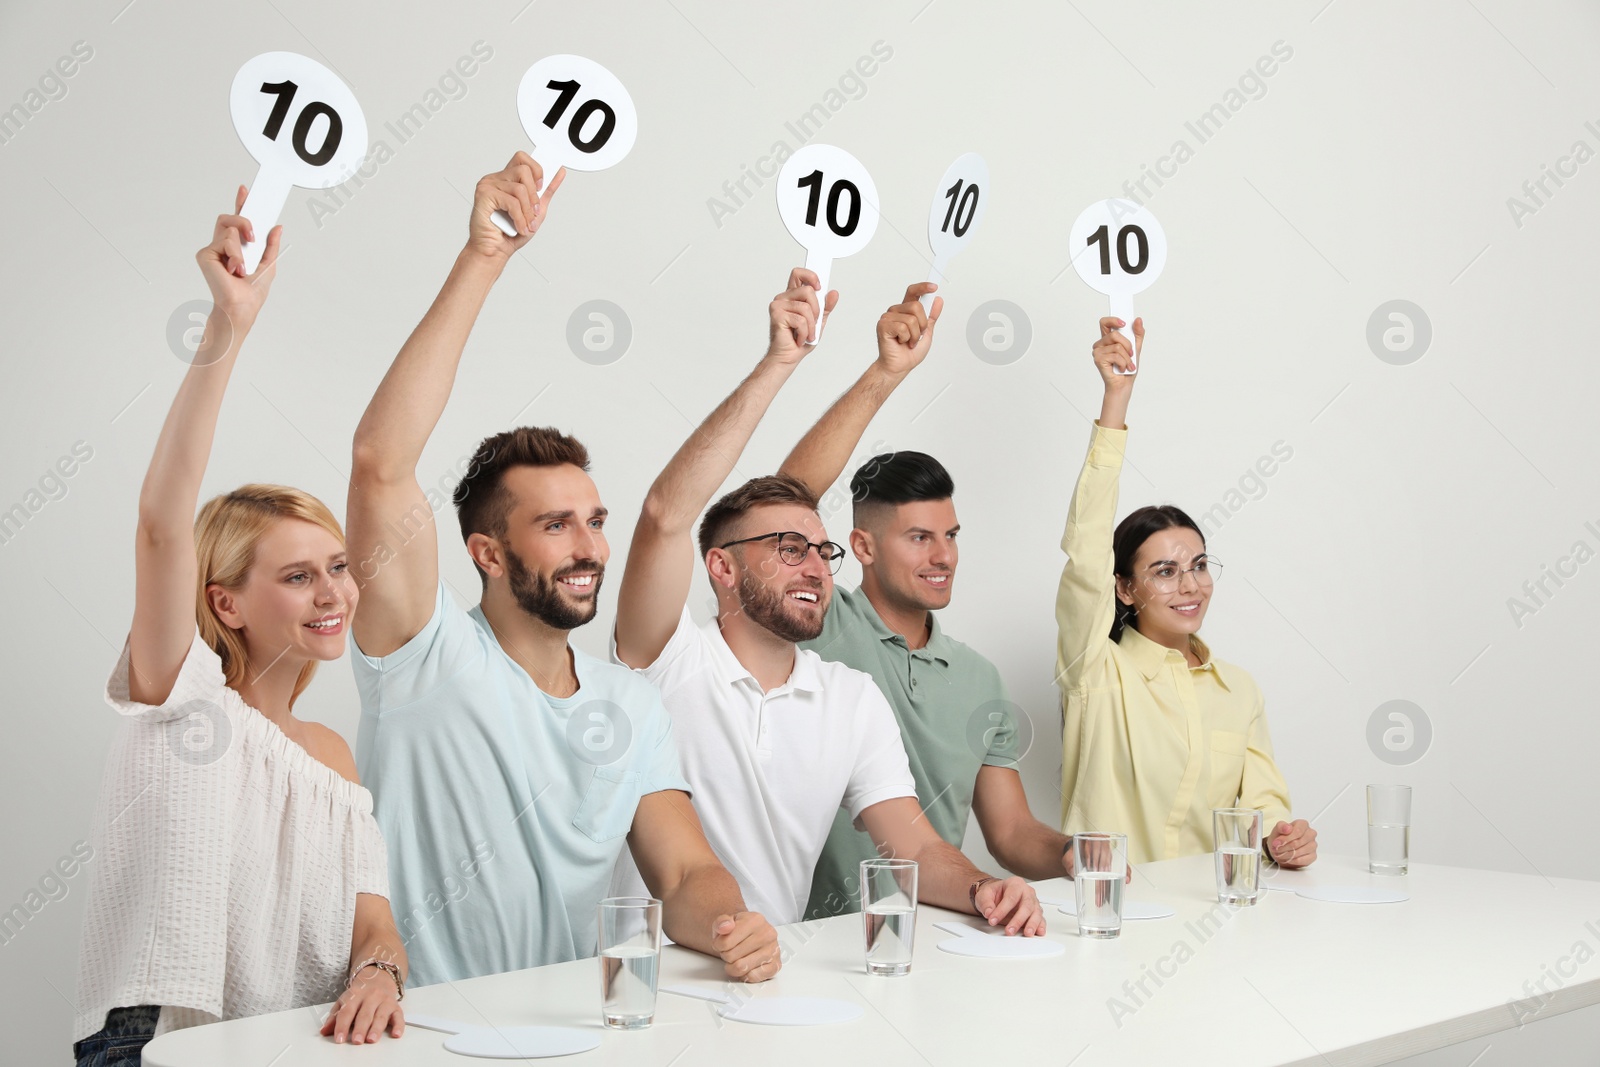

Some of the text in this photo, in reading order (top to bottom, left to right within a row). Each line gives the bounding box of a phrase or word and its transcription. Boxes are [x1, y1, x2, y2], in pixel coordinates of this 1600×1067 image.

[259, 79, 343, 167] 10
[542, 79, 616, 154] 10
[797, 169, 862, 238] 10
[941, 178, 980, 238] 10
[1086, 224, 1150, 275] 10
